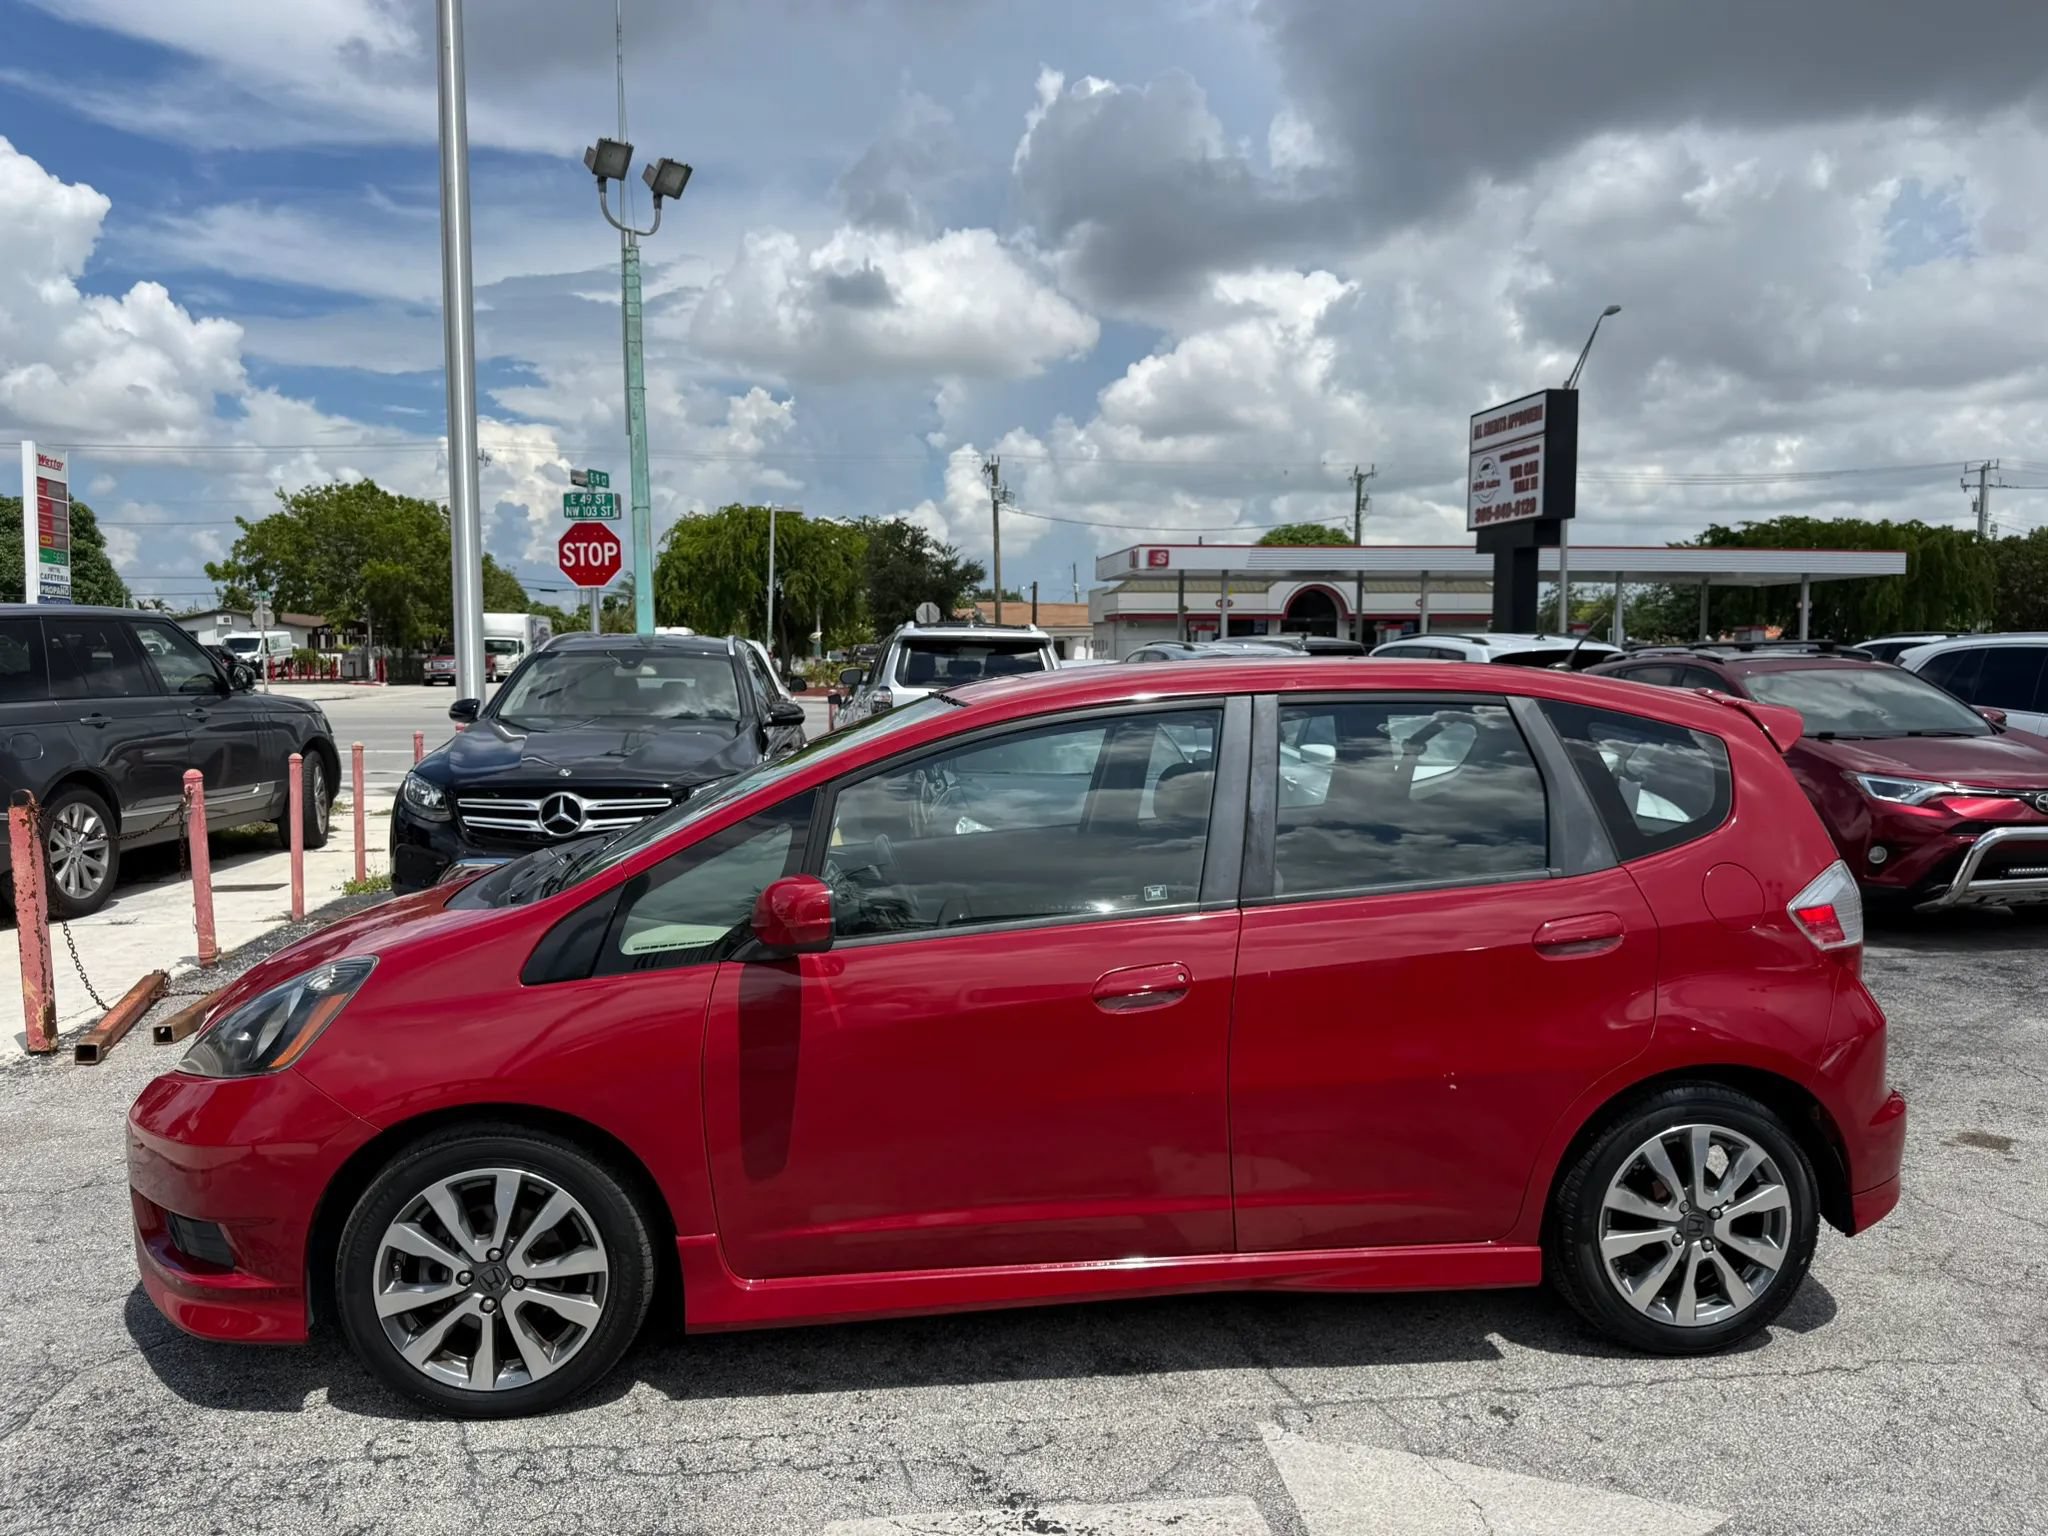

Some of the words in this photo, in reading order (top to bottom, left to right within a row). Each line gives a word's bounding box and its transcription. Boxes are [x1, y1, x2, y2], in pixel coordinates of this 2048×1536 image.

[571, 494, 577, 505] E
[580, 494, 592, 505] 49
[595, 494, 606, 505] ST
[566, 506, 580, 517] NW
[583, 506, 597, 517] 103
[600, 506, 612, 517] ST
[562, 542, 618, 567] STOP
[40, 572, 69, 583] CAFETERIA
